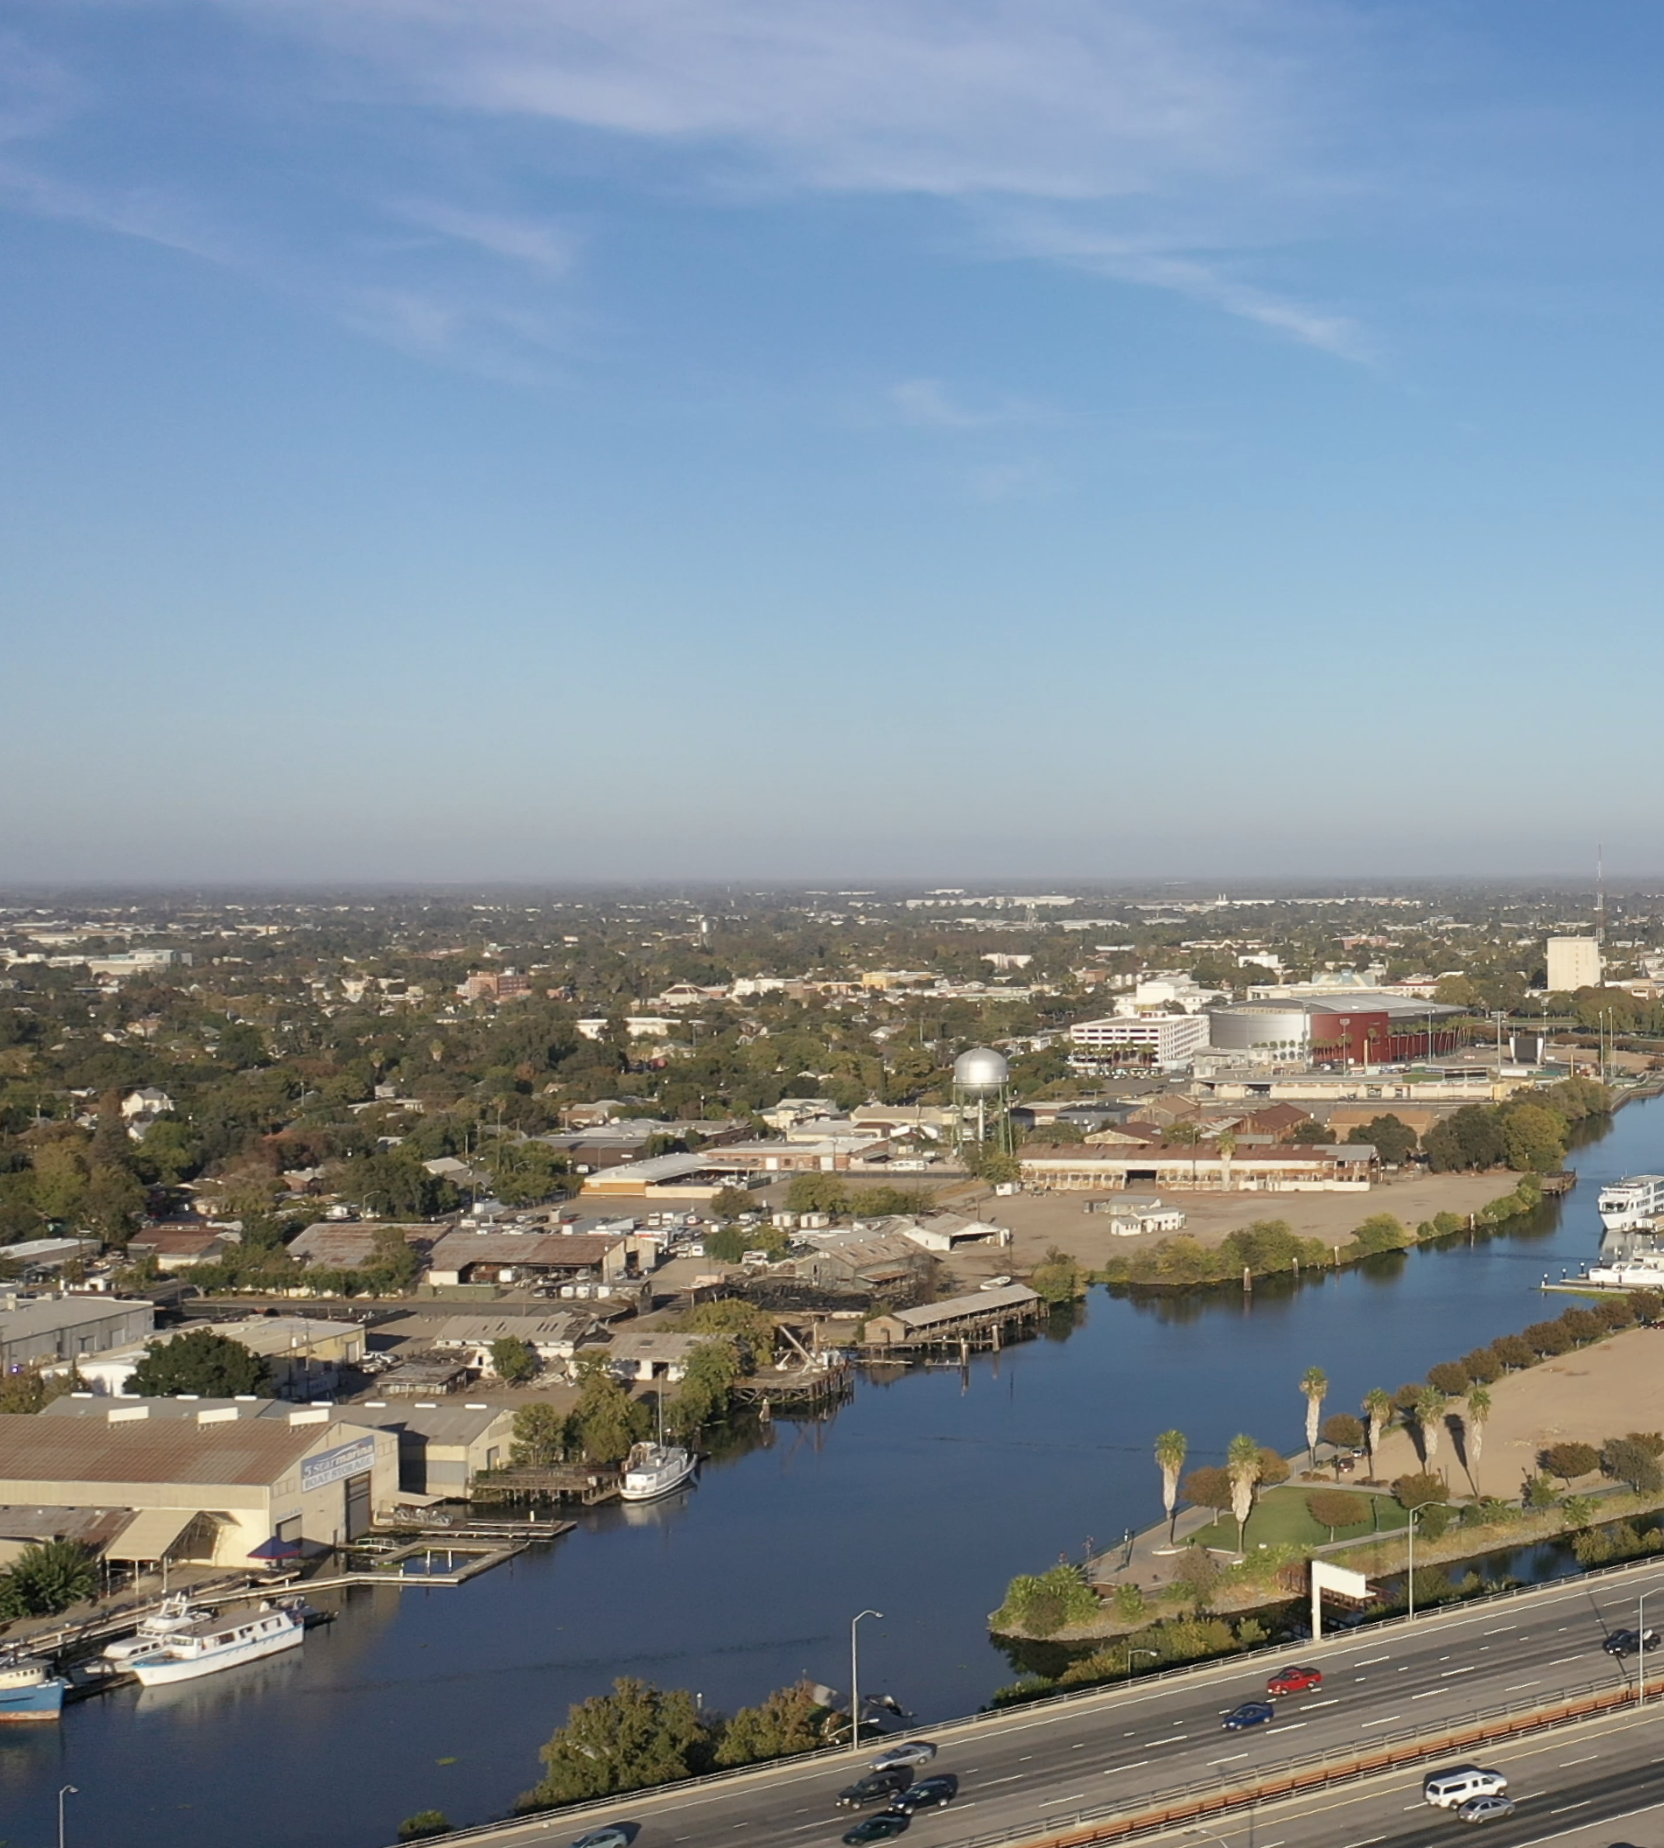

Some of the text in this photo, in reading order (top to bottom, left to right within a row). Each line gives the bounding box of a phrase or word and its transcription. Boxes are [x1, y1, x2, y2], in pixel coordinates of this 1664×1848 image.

[303, 1465, 312, 1478] 5
[304, 1455, 373, 1490] BOAT STORAGE
